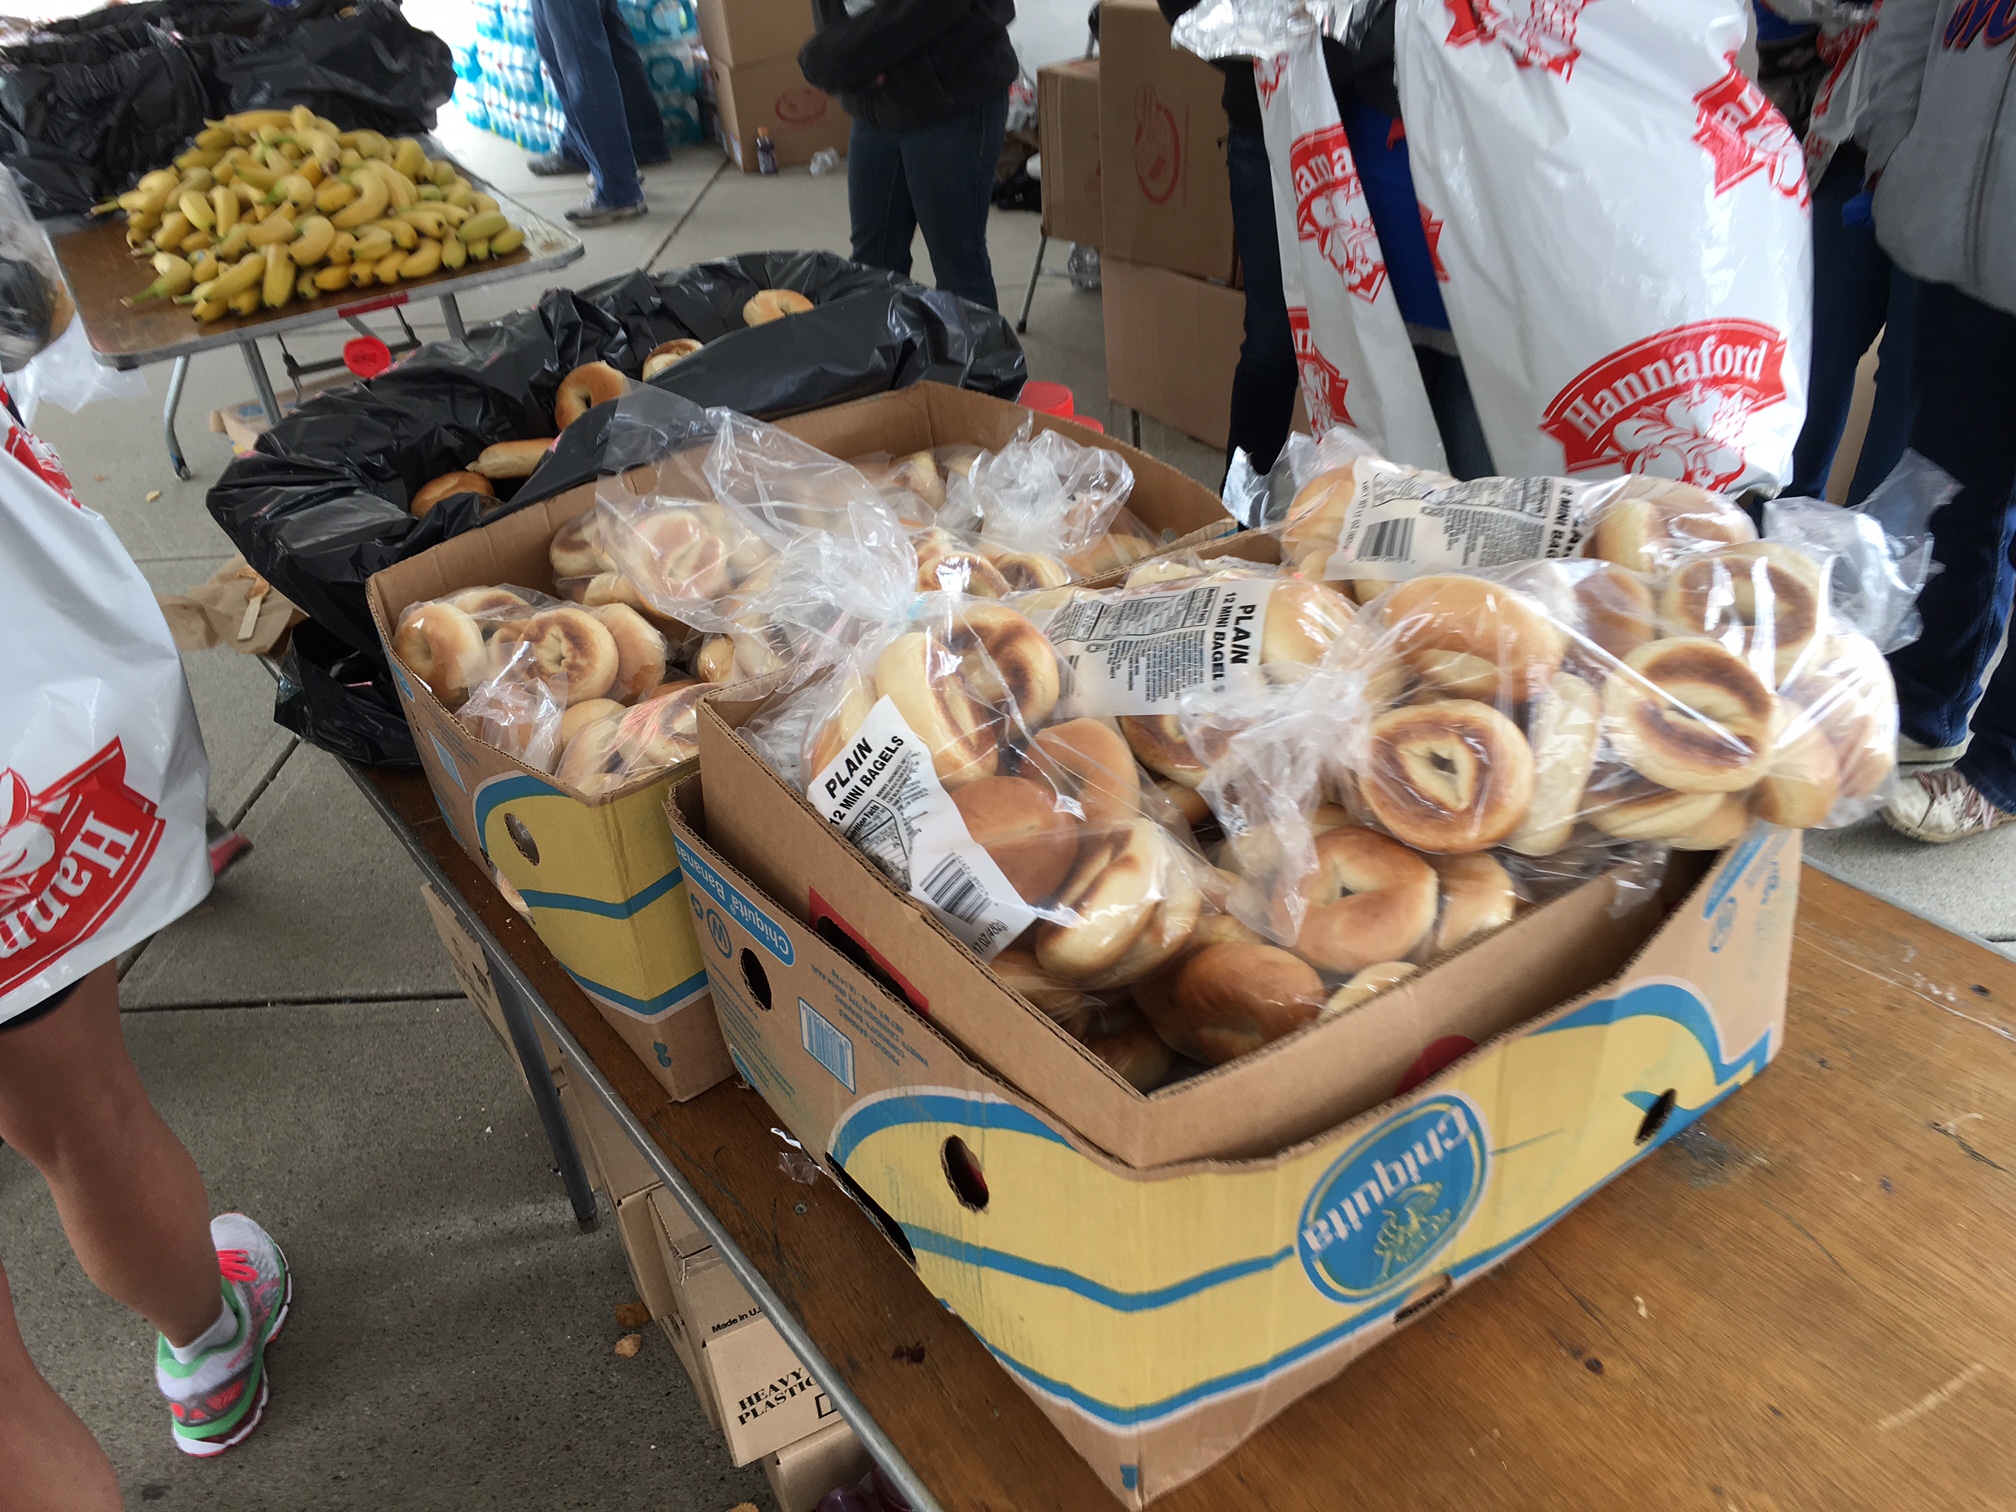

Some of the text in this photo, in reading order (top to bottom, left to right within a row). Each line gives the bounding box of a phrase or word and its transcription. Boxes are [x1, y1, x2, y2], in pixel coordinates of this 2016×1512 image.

[1561, 335, 1769, 441] Hannaford
[1553, 497, 1570, 525] MINI
[1214, 606, 1231, 627] MINI
[1224, 592, 1236, 603] 12
[1230, 604, 1256, 664] PLAIN
[824, 736, 874, 799] PLAIN
[827, 734, 904, 827] 12 MINI BAGELS
[863, 804, 879, 818] Facts
[1301, 1105, 1470, 1252] Chiquita
[711, 1319, 738, 1333] Made
[737, 1374, 818, 1427] PLASTIC
[738, 1367, 803, 1412] HEAVY
